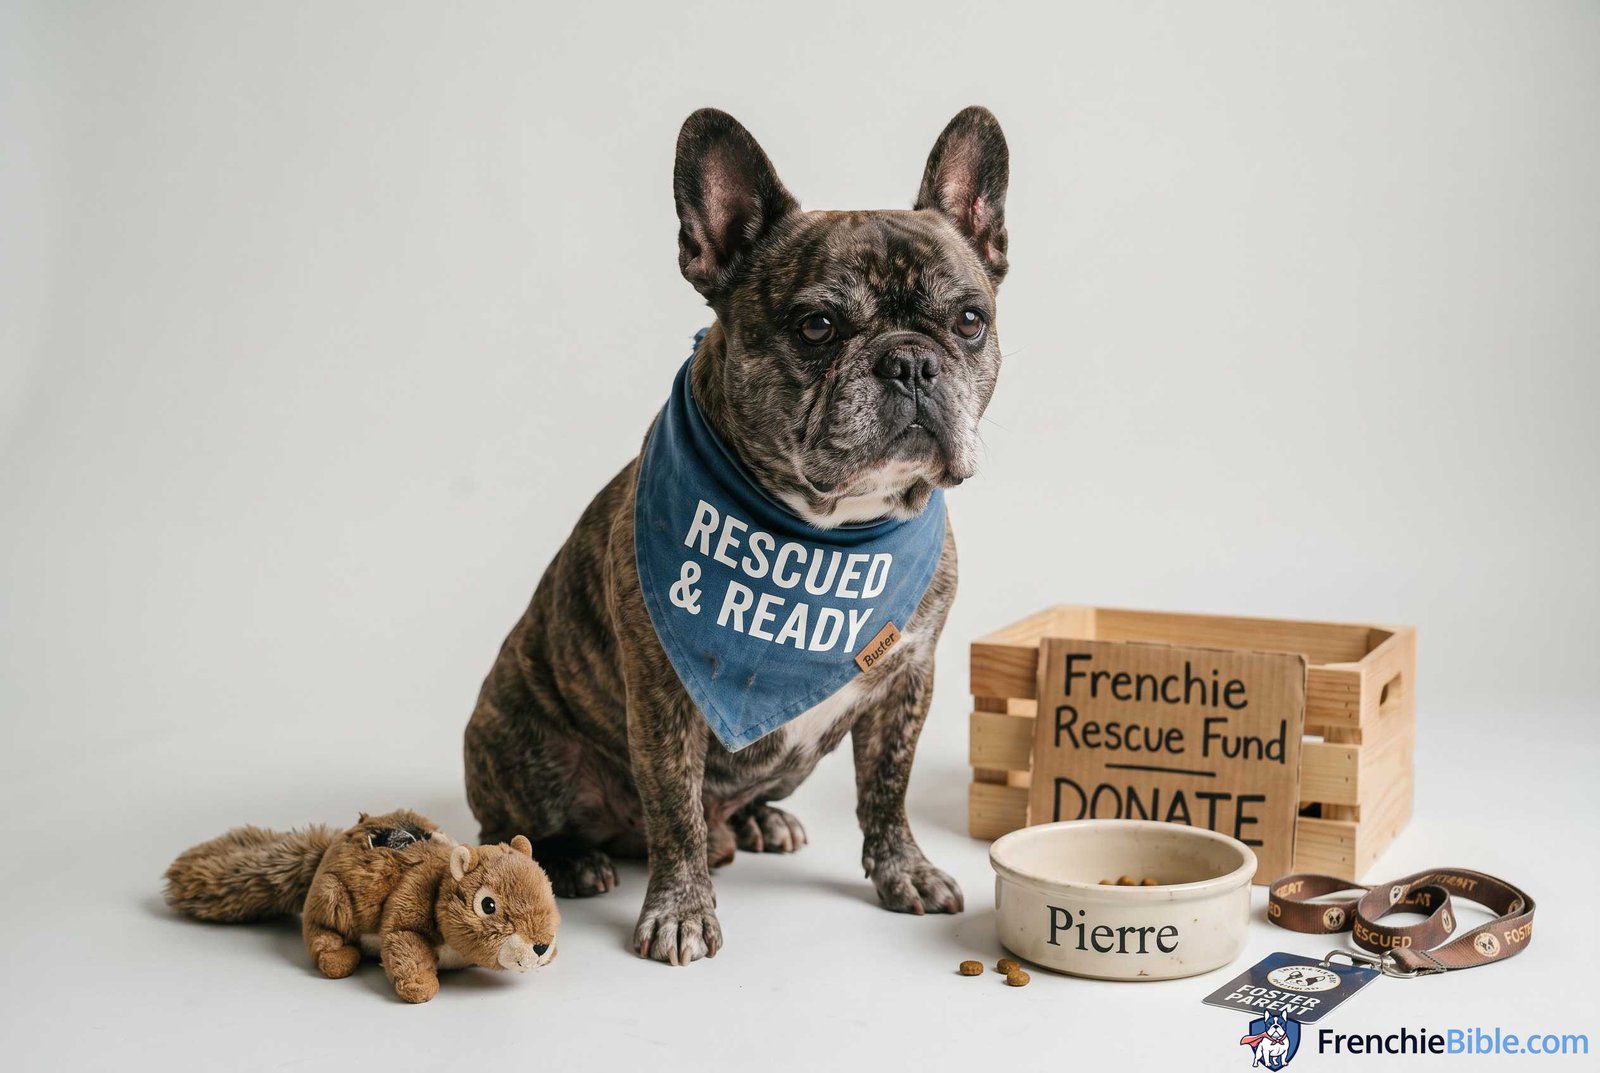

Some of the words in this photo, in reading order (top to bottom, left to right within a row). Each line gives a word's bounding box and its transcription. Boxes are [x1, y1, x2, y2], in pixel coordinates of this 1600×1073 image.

[683, 498, 893, 600] RESCUED
[668, 560, 703, 615] &
[716, 580, 874, 654] READY
[862, 631, 896, 668] Buster
[1064, 653, 1249, 710] Frenchie
[1054, 705, 1185, 754] Rescue
[1202, 717, 1287, 765] Fund
[1053, 777, 1266, 847] DONATE
[1046, 904, 1179, 954] Pierre
[1224, 992, 1314, 1016] PARENT
[1236, 984, 1321, 1008] FOSTER
